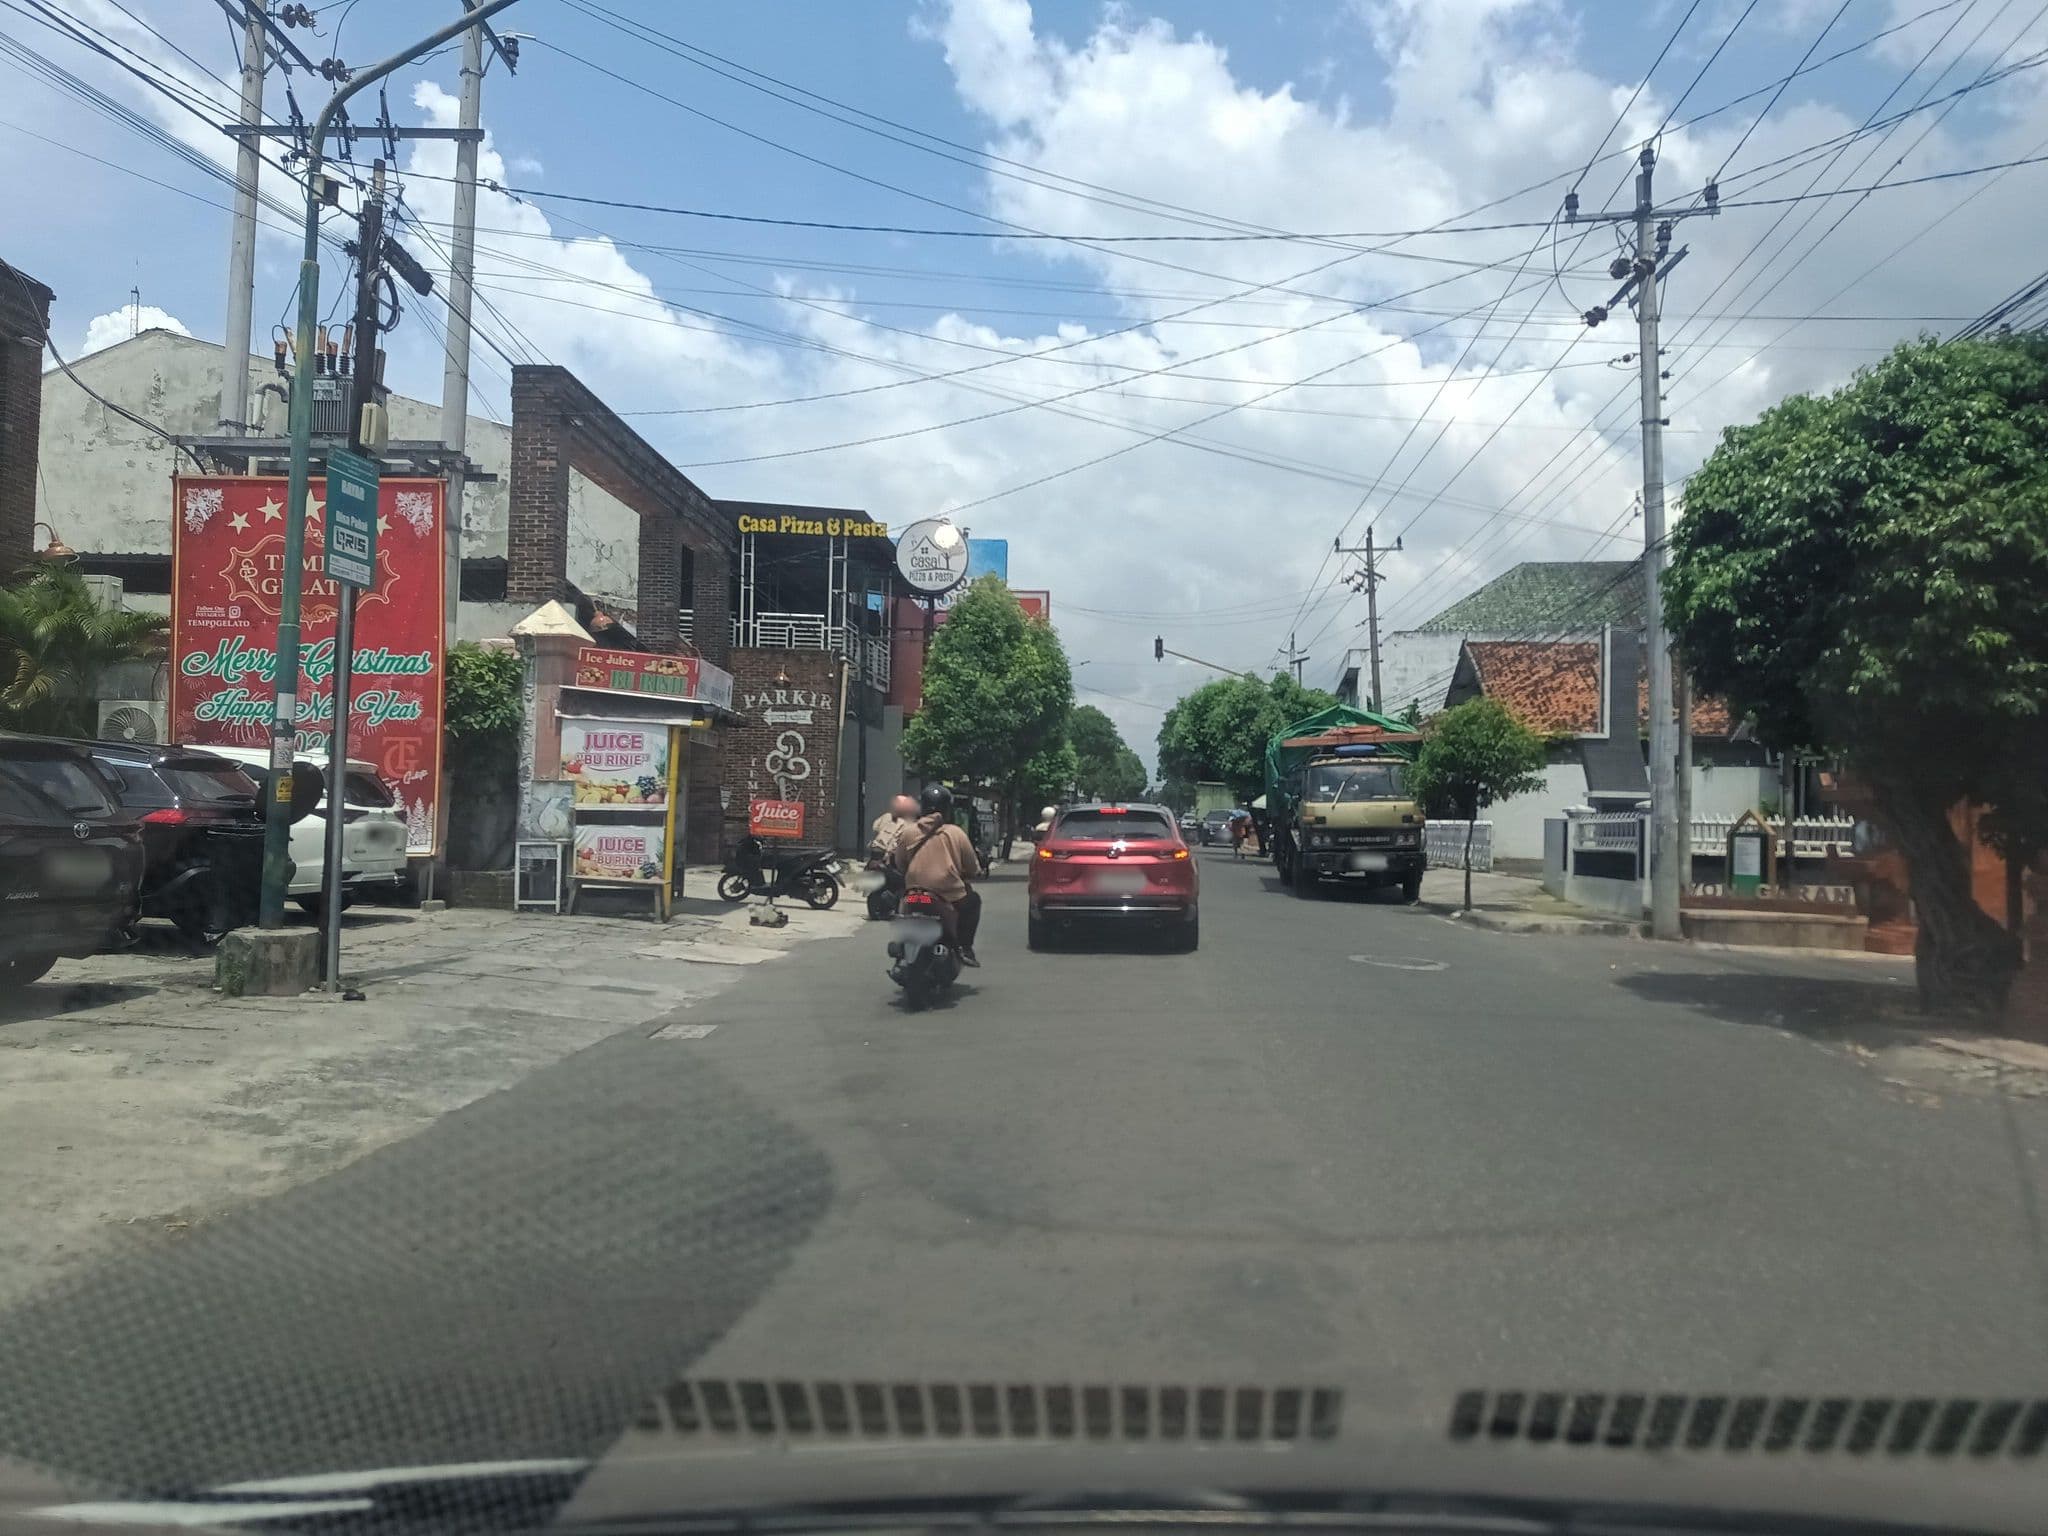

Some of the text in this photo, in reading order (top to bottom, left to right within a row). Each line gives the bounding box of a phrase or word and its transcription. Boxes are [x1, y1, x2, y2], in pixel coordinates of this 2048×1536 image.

[738, 515, 887, 537] Casa Pizza & Pasta
[336, 529, 366, 553] QRIS
[188, 619, 250, 628] TEMPOGELATO
[181, 635, 278, 683] Merry
[297, 637, 433, 683] Cistmas
[585, 652, 635, 667] Ice Juice
[195, 688, 276, 725] Happy
[296, 692, 352, 722] Ne
[356, 689, 422, 726] Year
[743, 689, 832, 710] PARKIR
[585, 733, 644, 751] JUICE
[754, 801, 800, 823] Juice
[598, 837, 646, 853] JUICE
